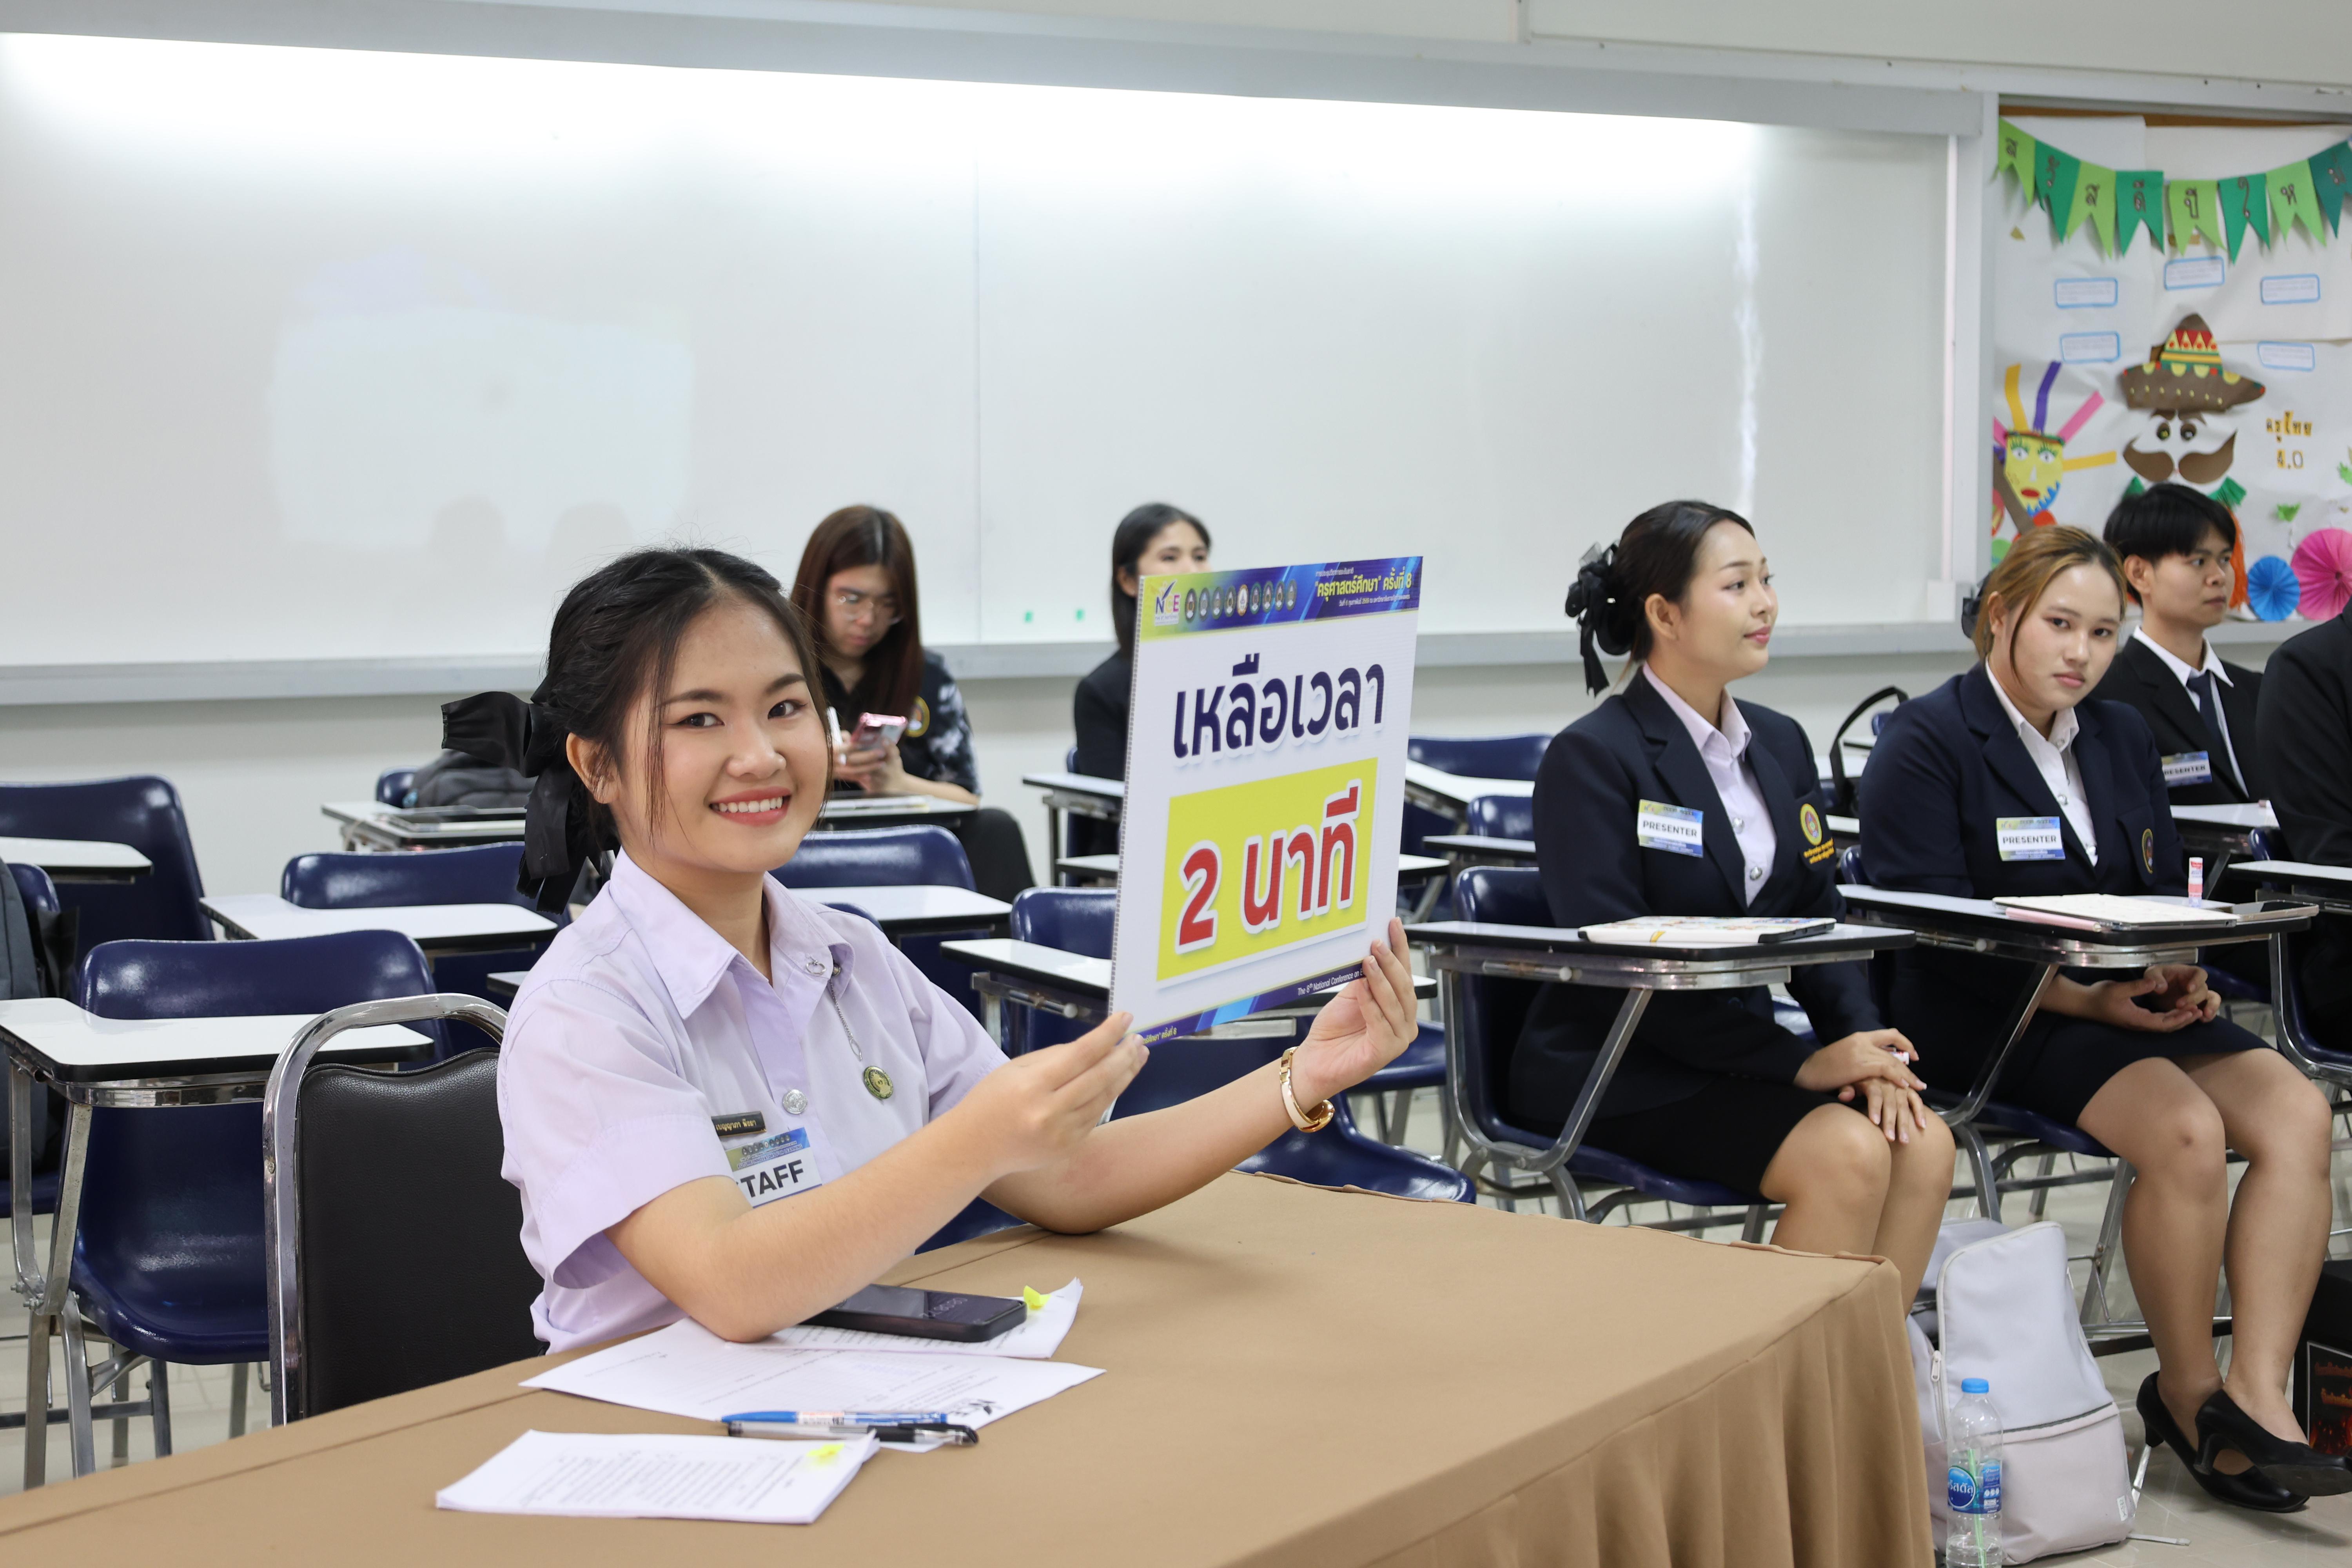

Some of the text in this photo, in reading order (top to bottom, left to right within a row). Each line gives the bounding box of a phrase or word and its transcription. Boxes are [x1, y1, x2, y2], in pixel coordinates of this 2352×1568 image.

[2277, 450, 2303, 469] 4.0
[1383, 566, 1405, 591] ครั้งที่
[1406, 573, 1412, 588] 8
[1174, 652, 1385, 759] เหลือเวลา
[2164, 765, 2205, 775] RESENTER
[1643, 820, 1697, 837] PRESENTER
[2003, 835, 2056, 844] PRESENTER
[1179, 786, 1359, 946] 2 นาที
[1298, 987, 1306, 996] The
[1313, 979, 1330, 991] National
[1331, 973, 1354, 985] Conference
[753, 1153, 775, 1163] INNOVATORS
[736, 1159, 804, 1198] TAFF
[1948, 1479, 1973, 1497] ริสตัล
